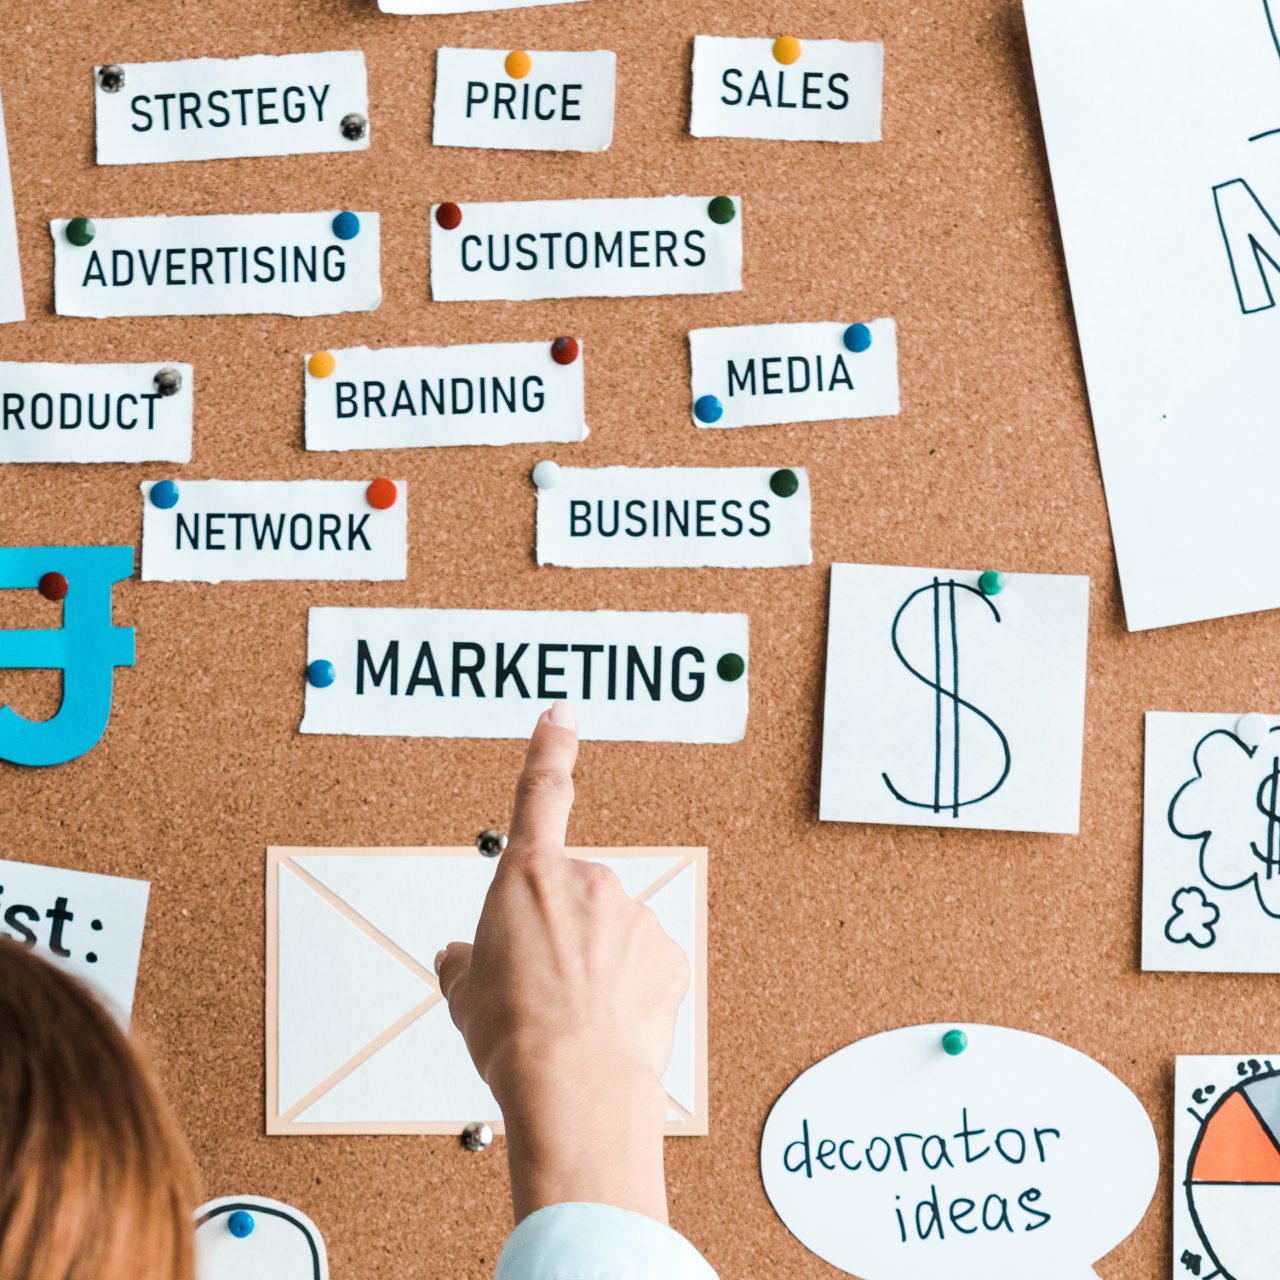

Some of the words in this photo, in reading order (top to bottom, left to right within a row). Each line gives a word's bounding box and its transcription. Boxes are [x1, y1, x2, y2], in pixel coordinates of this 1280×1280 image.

[131, 85, 329, 132] STRSTEGY
[467, 81, 582, 120] PRICE
[721, 69, 848, 110] SALES
[82, 244, 347, 287] ADVERTISING
[462, 230, 705, 272] CUSTOMERS
[728, 354, 854, 396] MEDIA
[336, 376, 544, 418] BRANDING
[176, 513, 371, 550] NETWORK
[570, 500, 770, 537] BUSINESS
[356, 640, 705, 702] MARKETING
[784, 1108, 1060, 1178] decorator
[896, 1185, 1051, 1242] ideas
